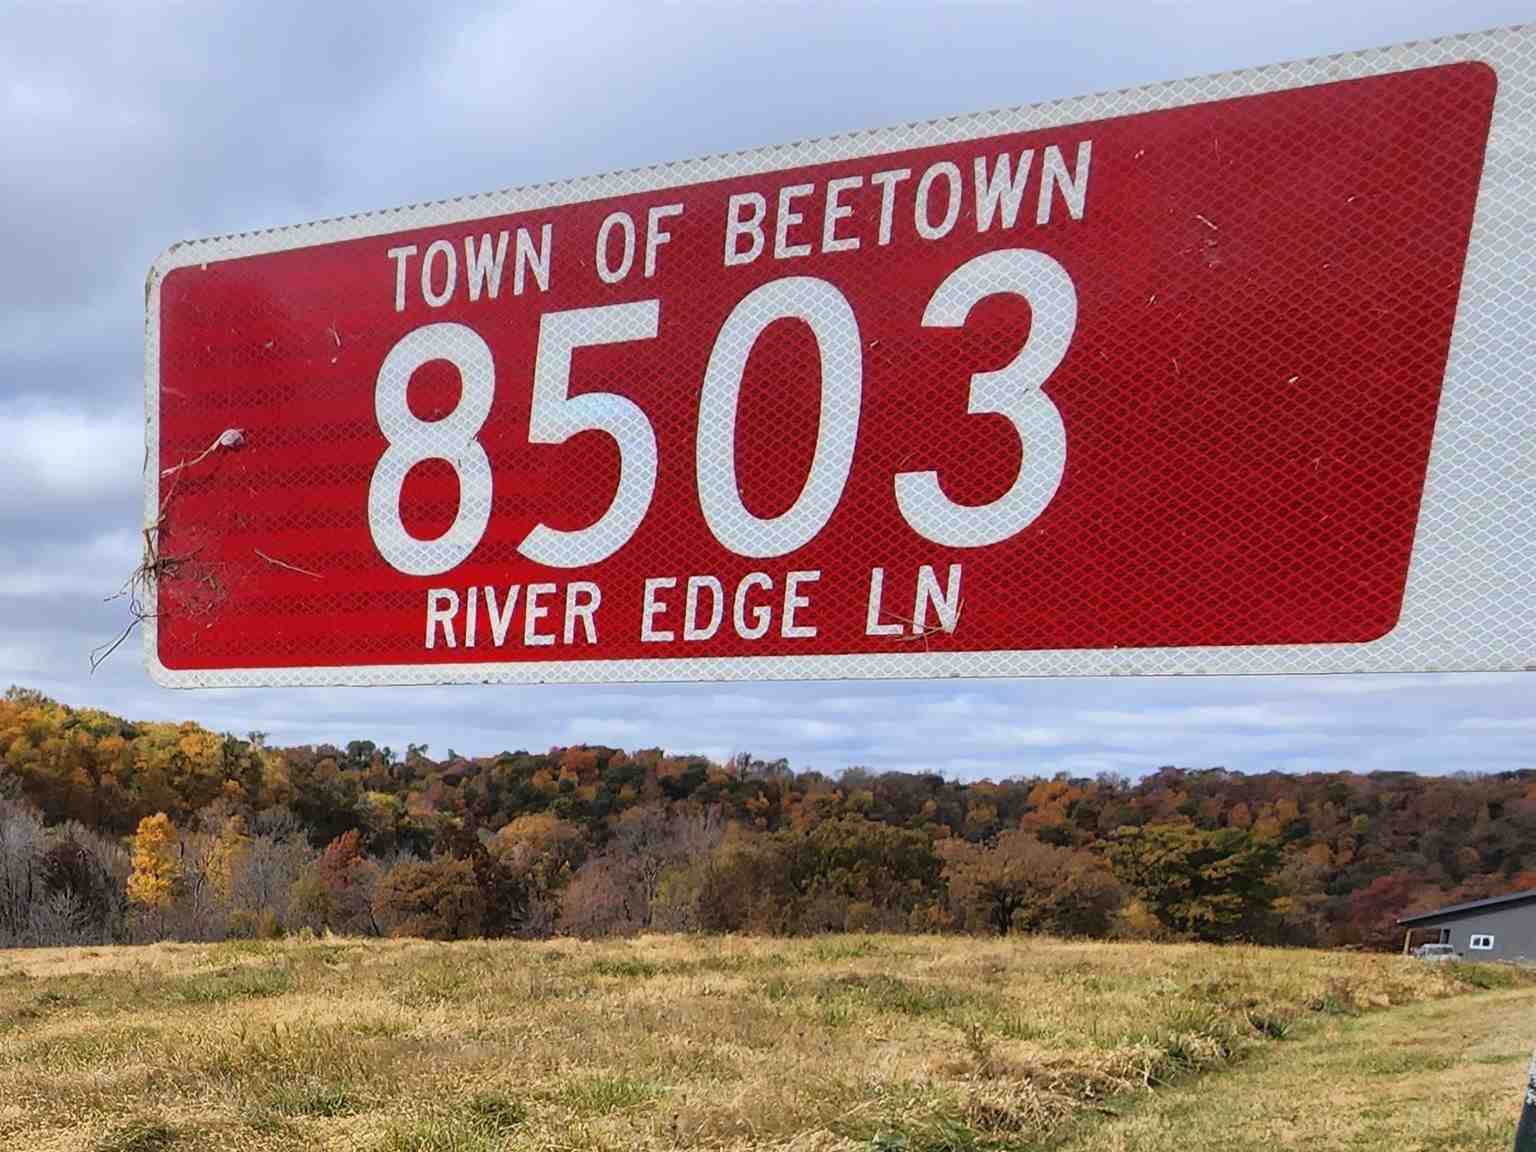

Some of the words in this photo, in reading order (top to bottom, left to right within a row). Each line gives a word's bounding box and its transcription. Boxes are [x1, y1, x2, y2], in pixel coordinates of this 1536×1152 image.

[387, 223, 553, 312] TOWN
[595, 203, 684, 284] OF
[724, 140, 1092, 267] BEETOWN
[367, 247, 1078, 577] 8503
[425, 581, 602, 649] RIVER
[640, 570, 821, 642] EDGE
[865, 563, 963, 636] LN
